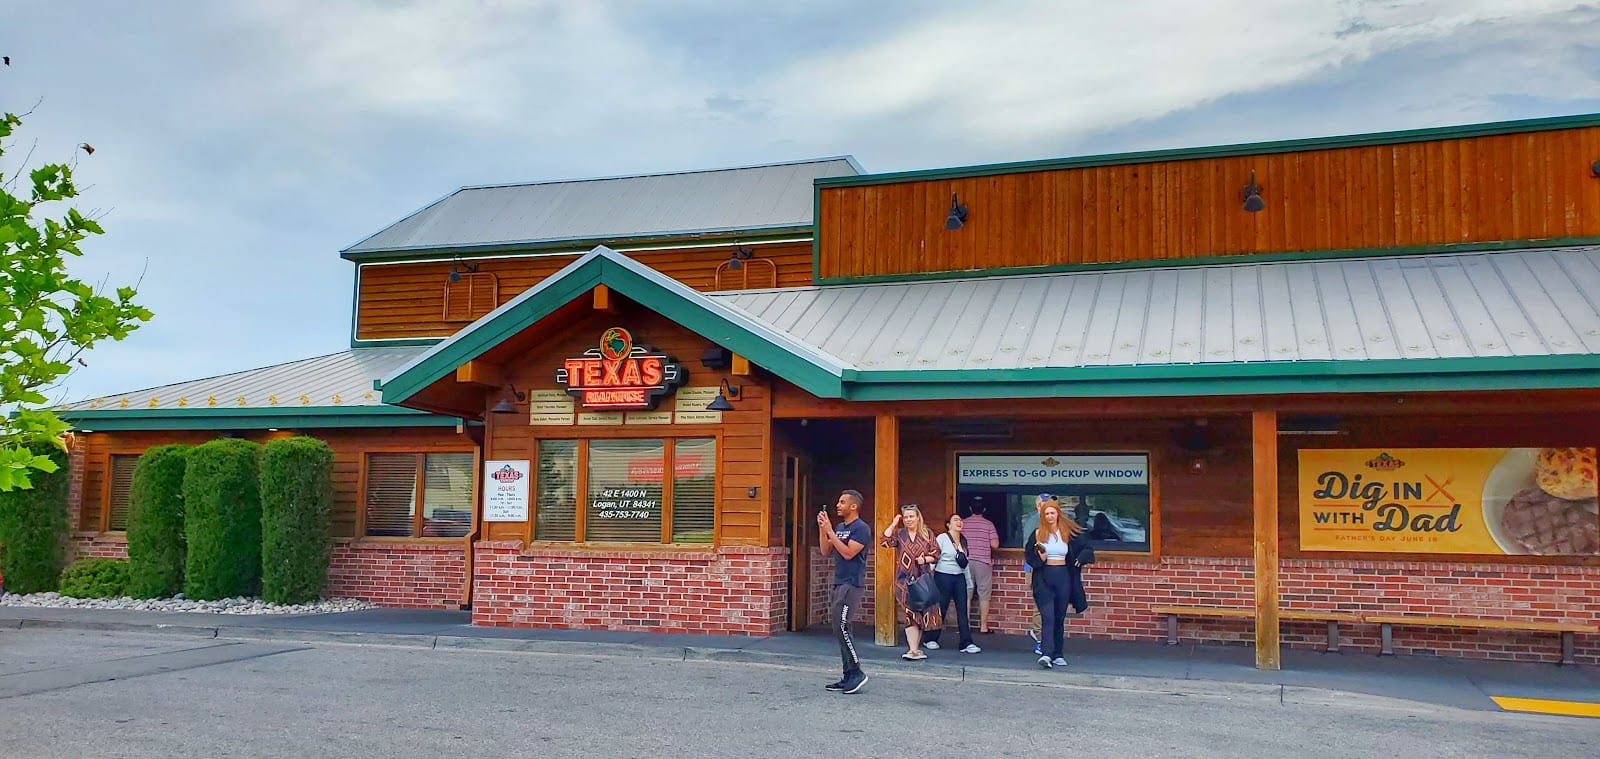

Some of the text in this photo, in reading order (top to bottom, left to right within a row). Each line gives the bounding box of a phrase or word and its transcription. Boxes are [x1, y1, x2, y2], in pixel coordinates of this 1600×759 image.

[565, 358, 662, 387] TEXAS
[495, 471, 519, 479] TEXAS
[962, 469, 1143, 478] EXPRESS TO-GO PICKUP WINDOW
[602, 490, 613, 498] 42
[621, 490, 639, 498] 1400
[1313, 471, 1422, 511] Dig IN
[592, 500, 617, 509] Logan,
[619, 500, 631, 508] UT
[599, 510, 650, 519] 435-753-7740
[1313, 503, 1463, 532] WITH Dad
